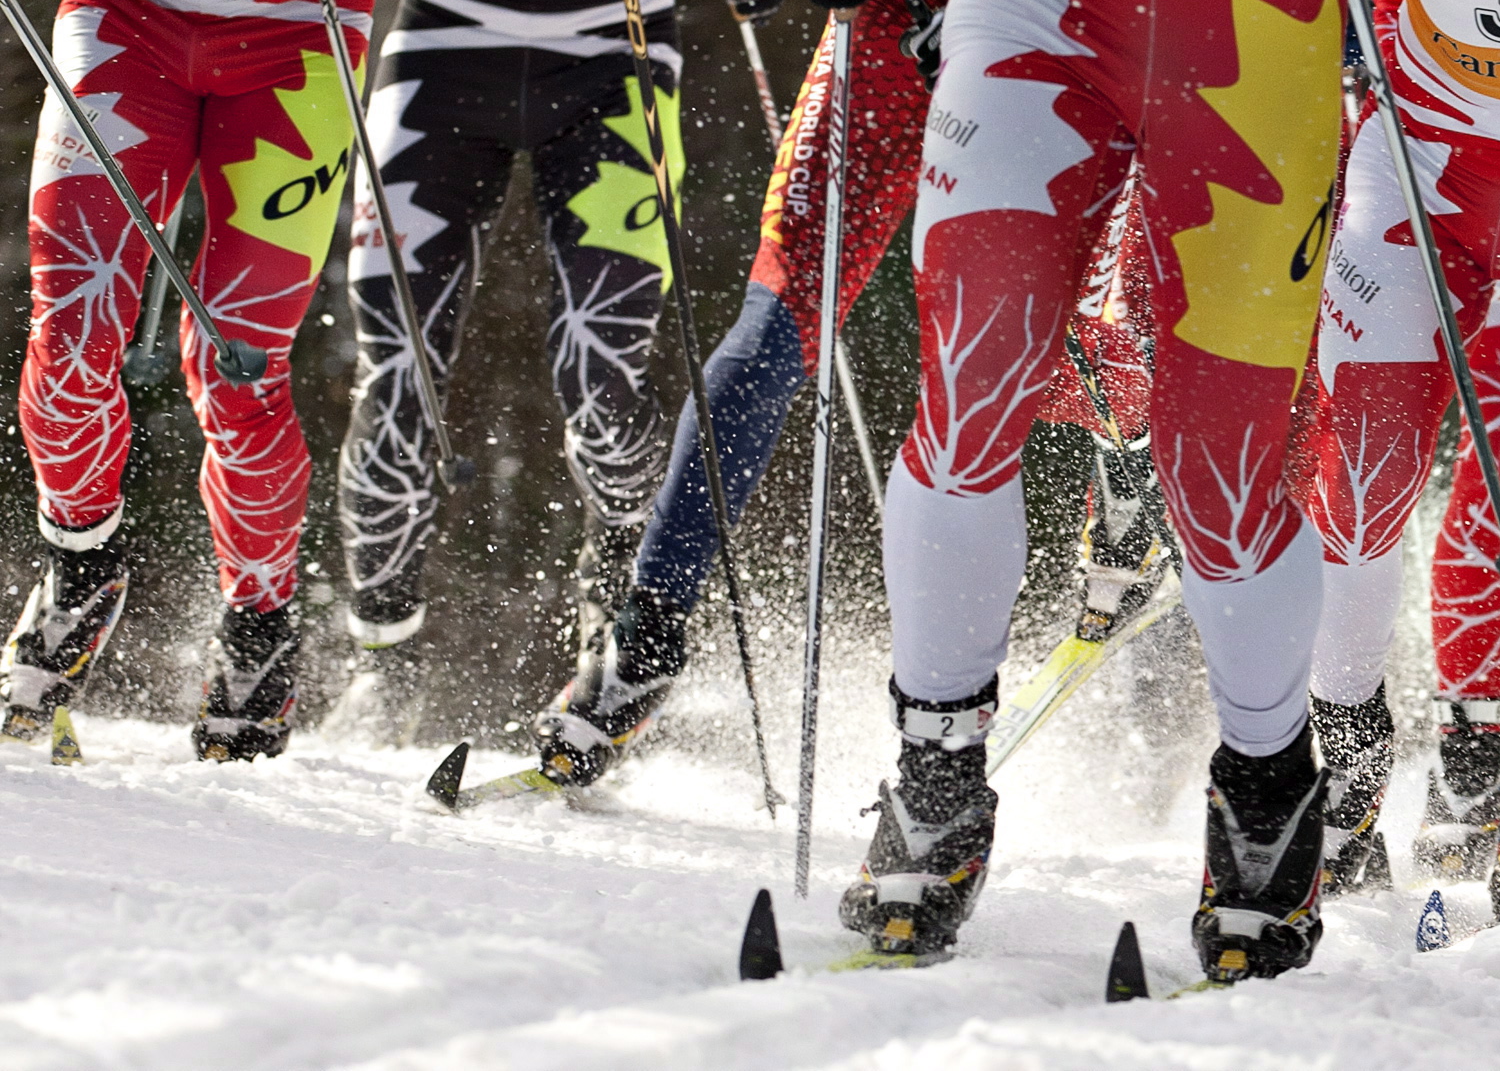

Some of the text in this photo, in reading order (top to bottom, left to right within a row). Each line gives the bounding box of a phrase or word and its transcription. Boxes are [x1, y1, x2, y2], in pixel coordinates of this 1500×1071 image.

[794, 81, 828, 162] WORLD
[787, 166, 811, 217] CUP
[941, 717, 955, 737] 2
